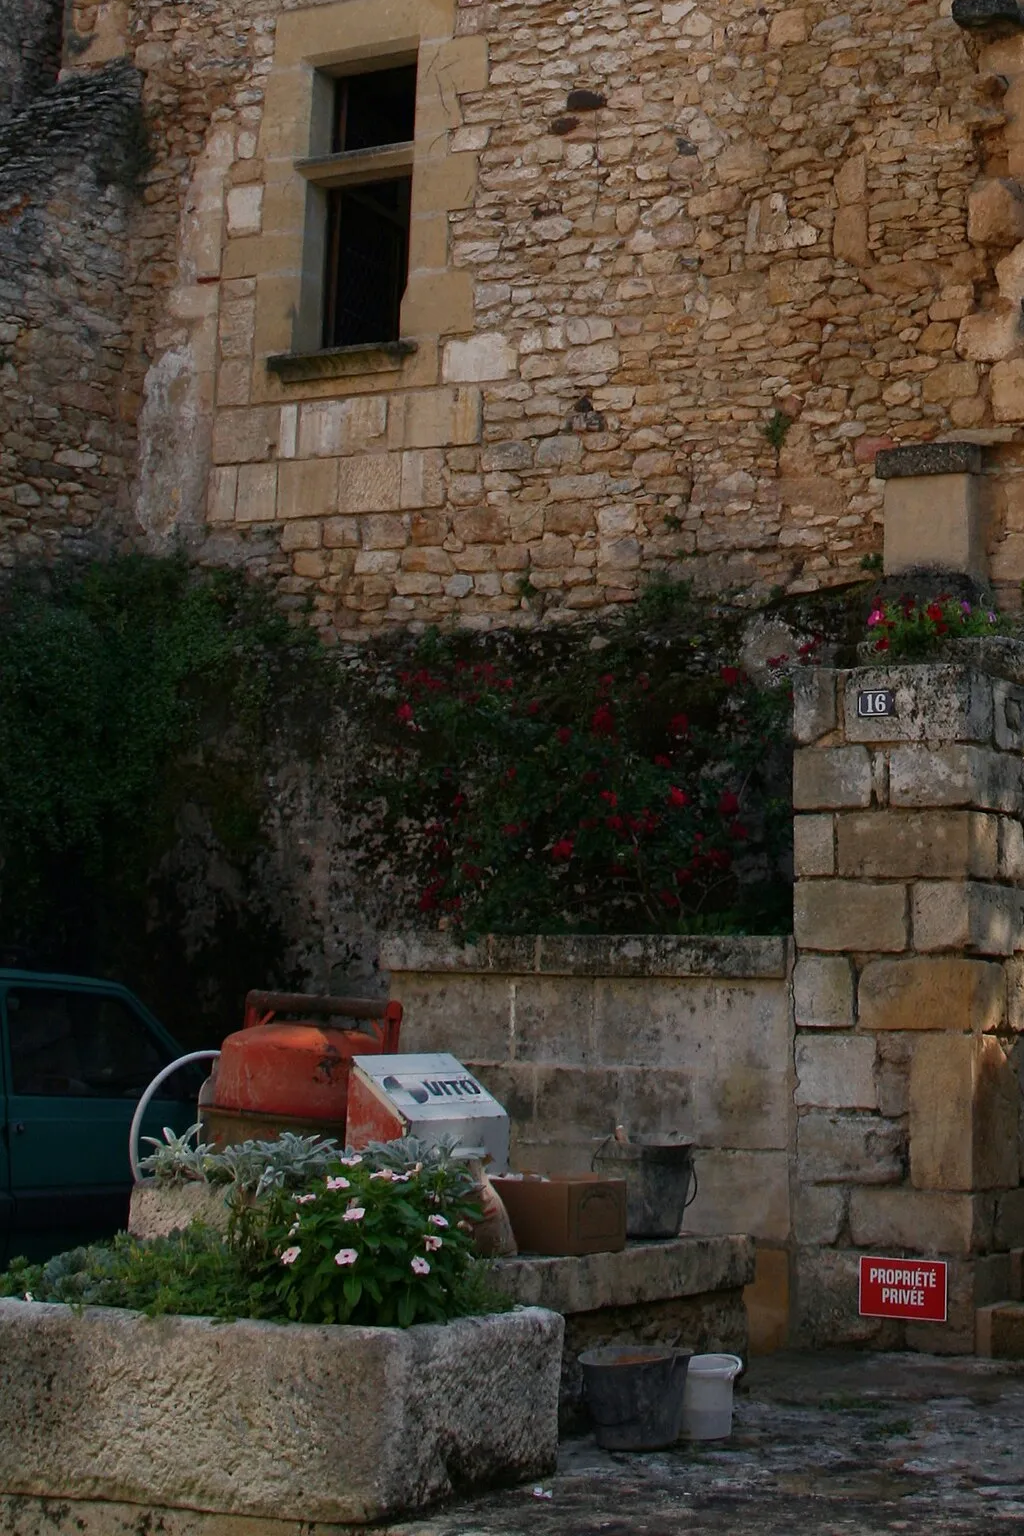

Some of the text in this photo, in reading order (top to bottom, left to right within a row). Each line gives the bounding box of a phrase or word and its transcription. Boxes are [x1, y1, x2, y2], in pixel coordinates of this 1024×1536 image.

[866, 693, 886, 713] 16
[421, 1079, 481, 1096] VITO
[869, 1267, 937, 1288] PROPRIÉTÉ
[881, 1286, 925, 1306] PRIVÉE
